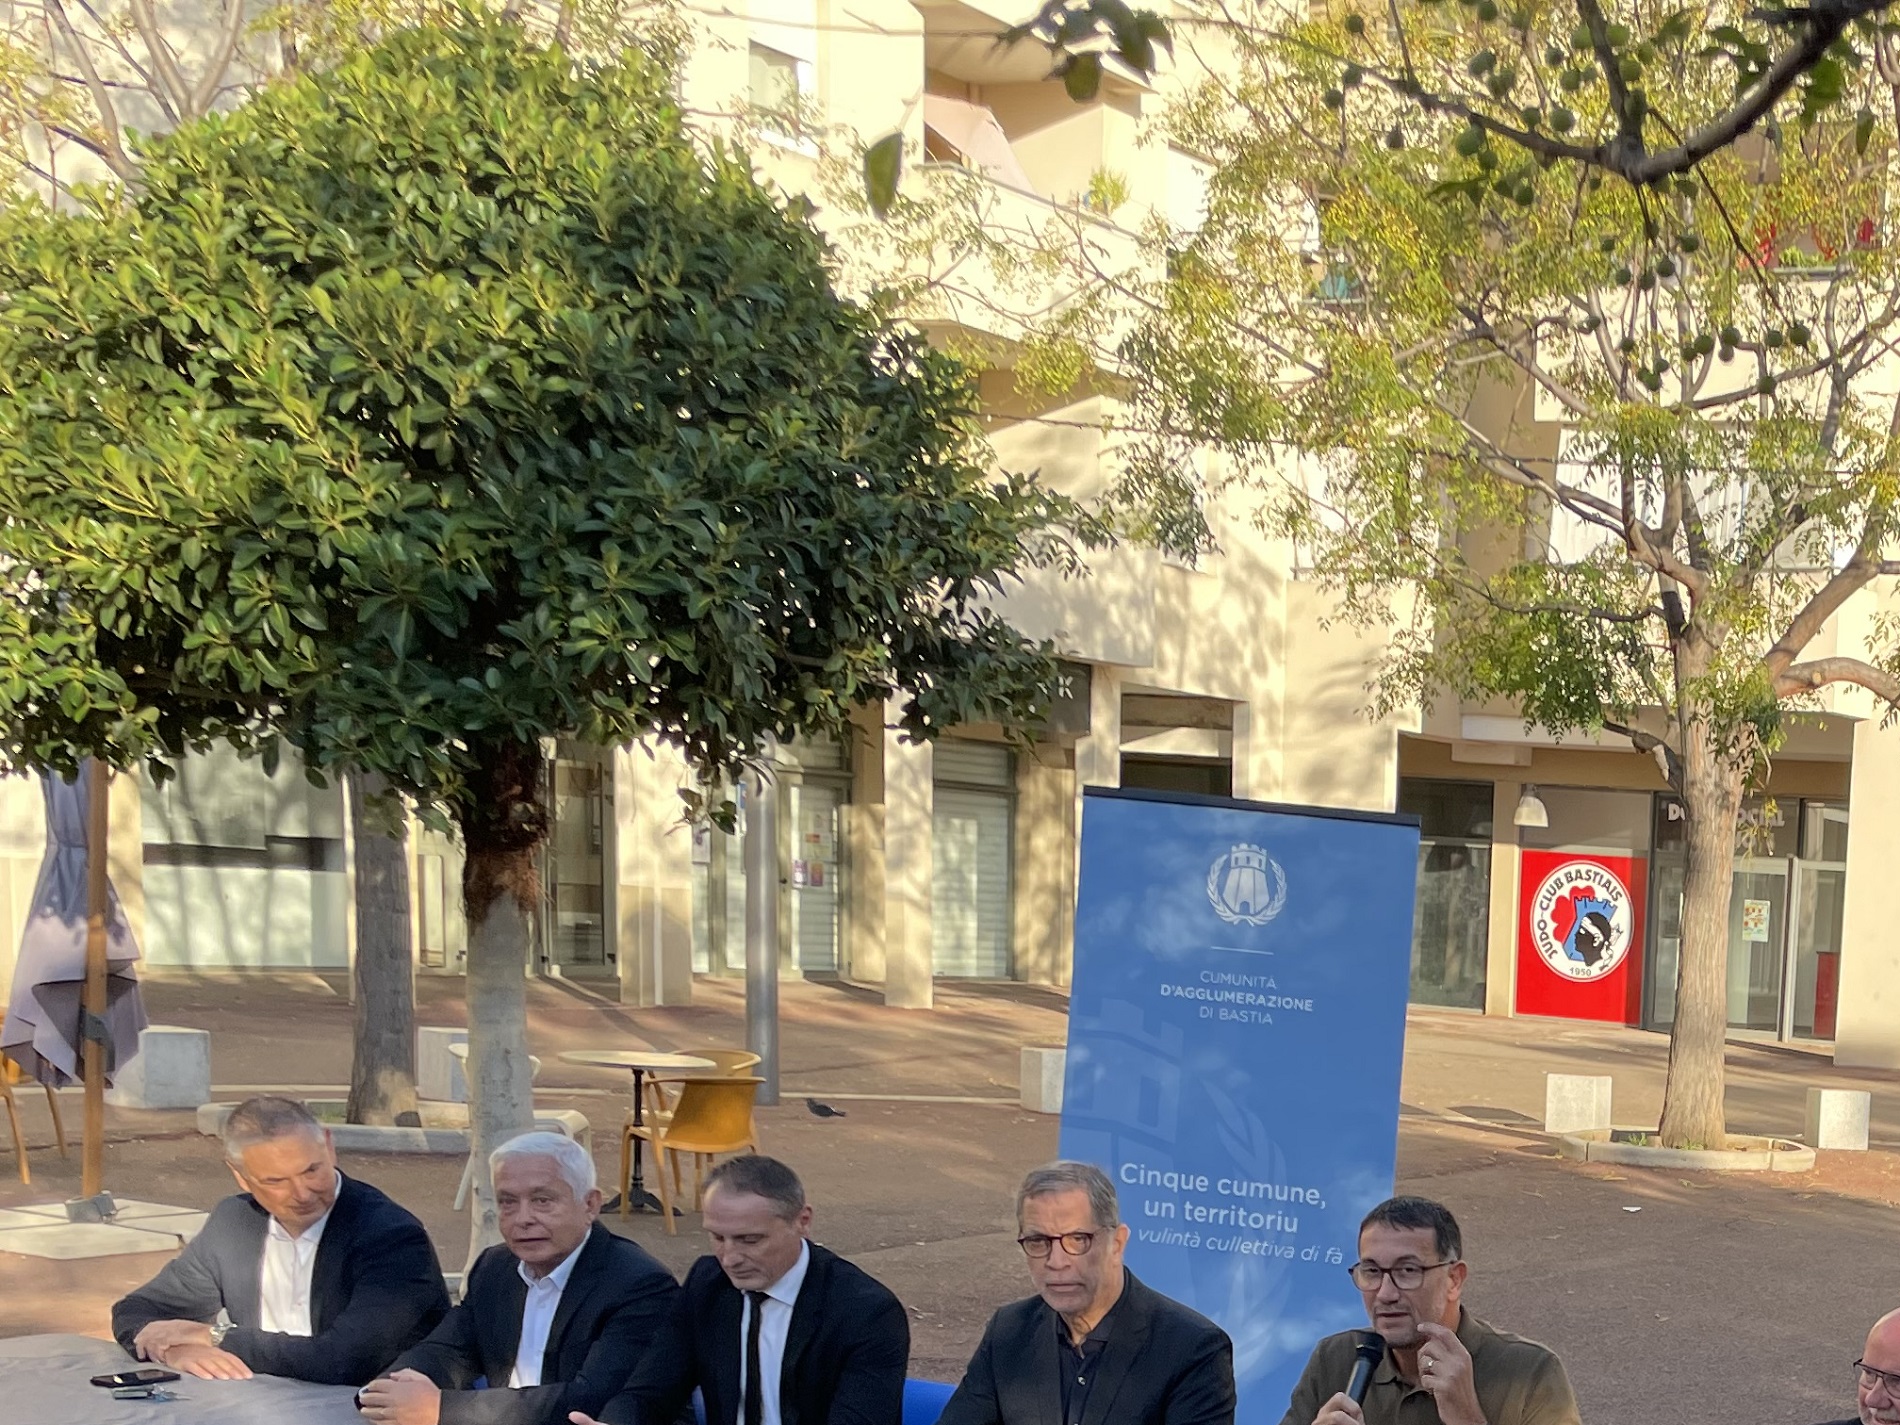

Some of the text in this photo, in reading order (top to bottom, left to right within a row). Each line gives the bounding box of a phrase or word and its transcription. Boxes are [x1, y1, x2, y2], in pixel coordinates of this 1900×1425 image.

[1565, 868, 1623, 902] BASTIAIS
[1569, 966, 1592, 977] 1950
[1160, 983, 1314, 1012] D'AGGLUMERAZIONE
[1199, 1005, 1273, 1025] DI BASTIA
[1120, 1162, 1327, 1210] Cinque cumune,
[1144, 1199, 1298, 1234] un territoriu
[1138, 1227, 1343, 1266] vulintà cullettiva di fà
